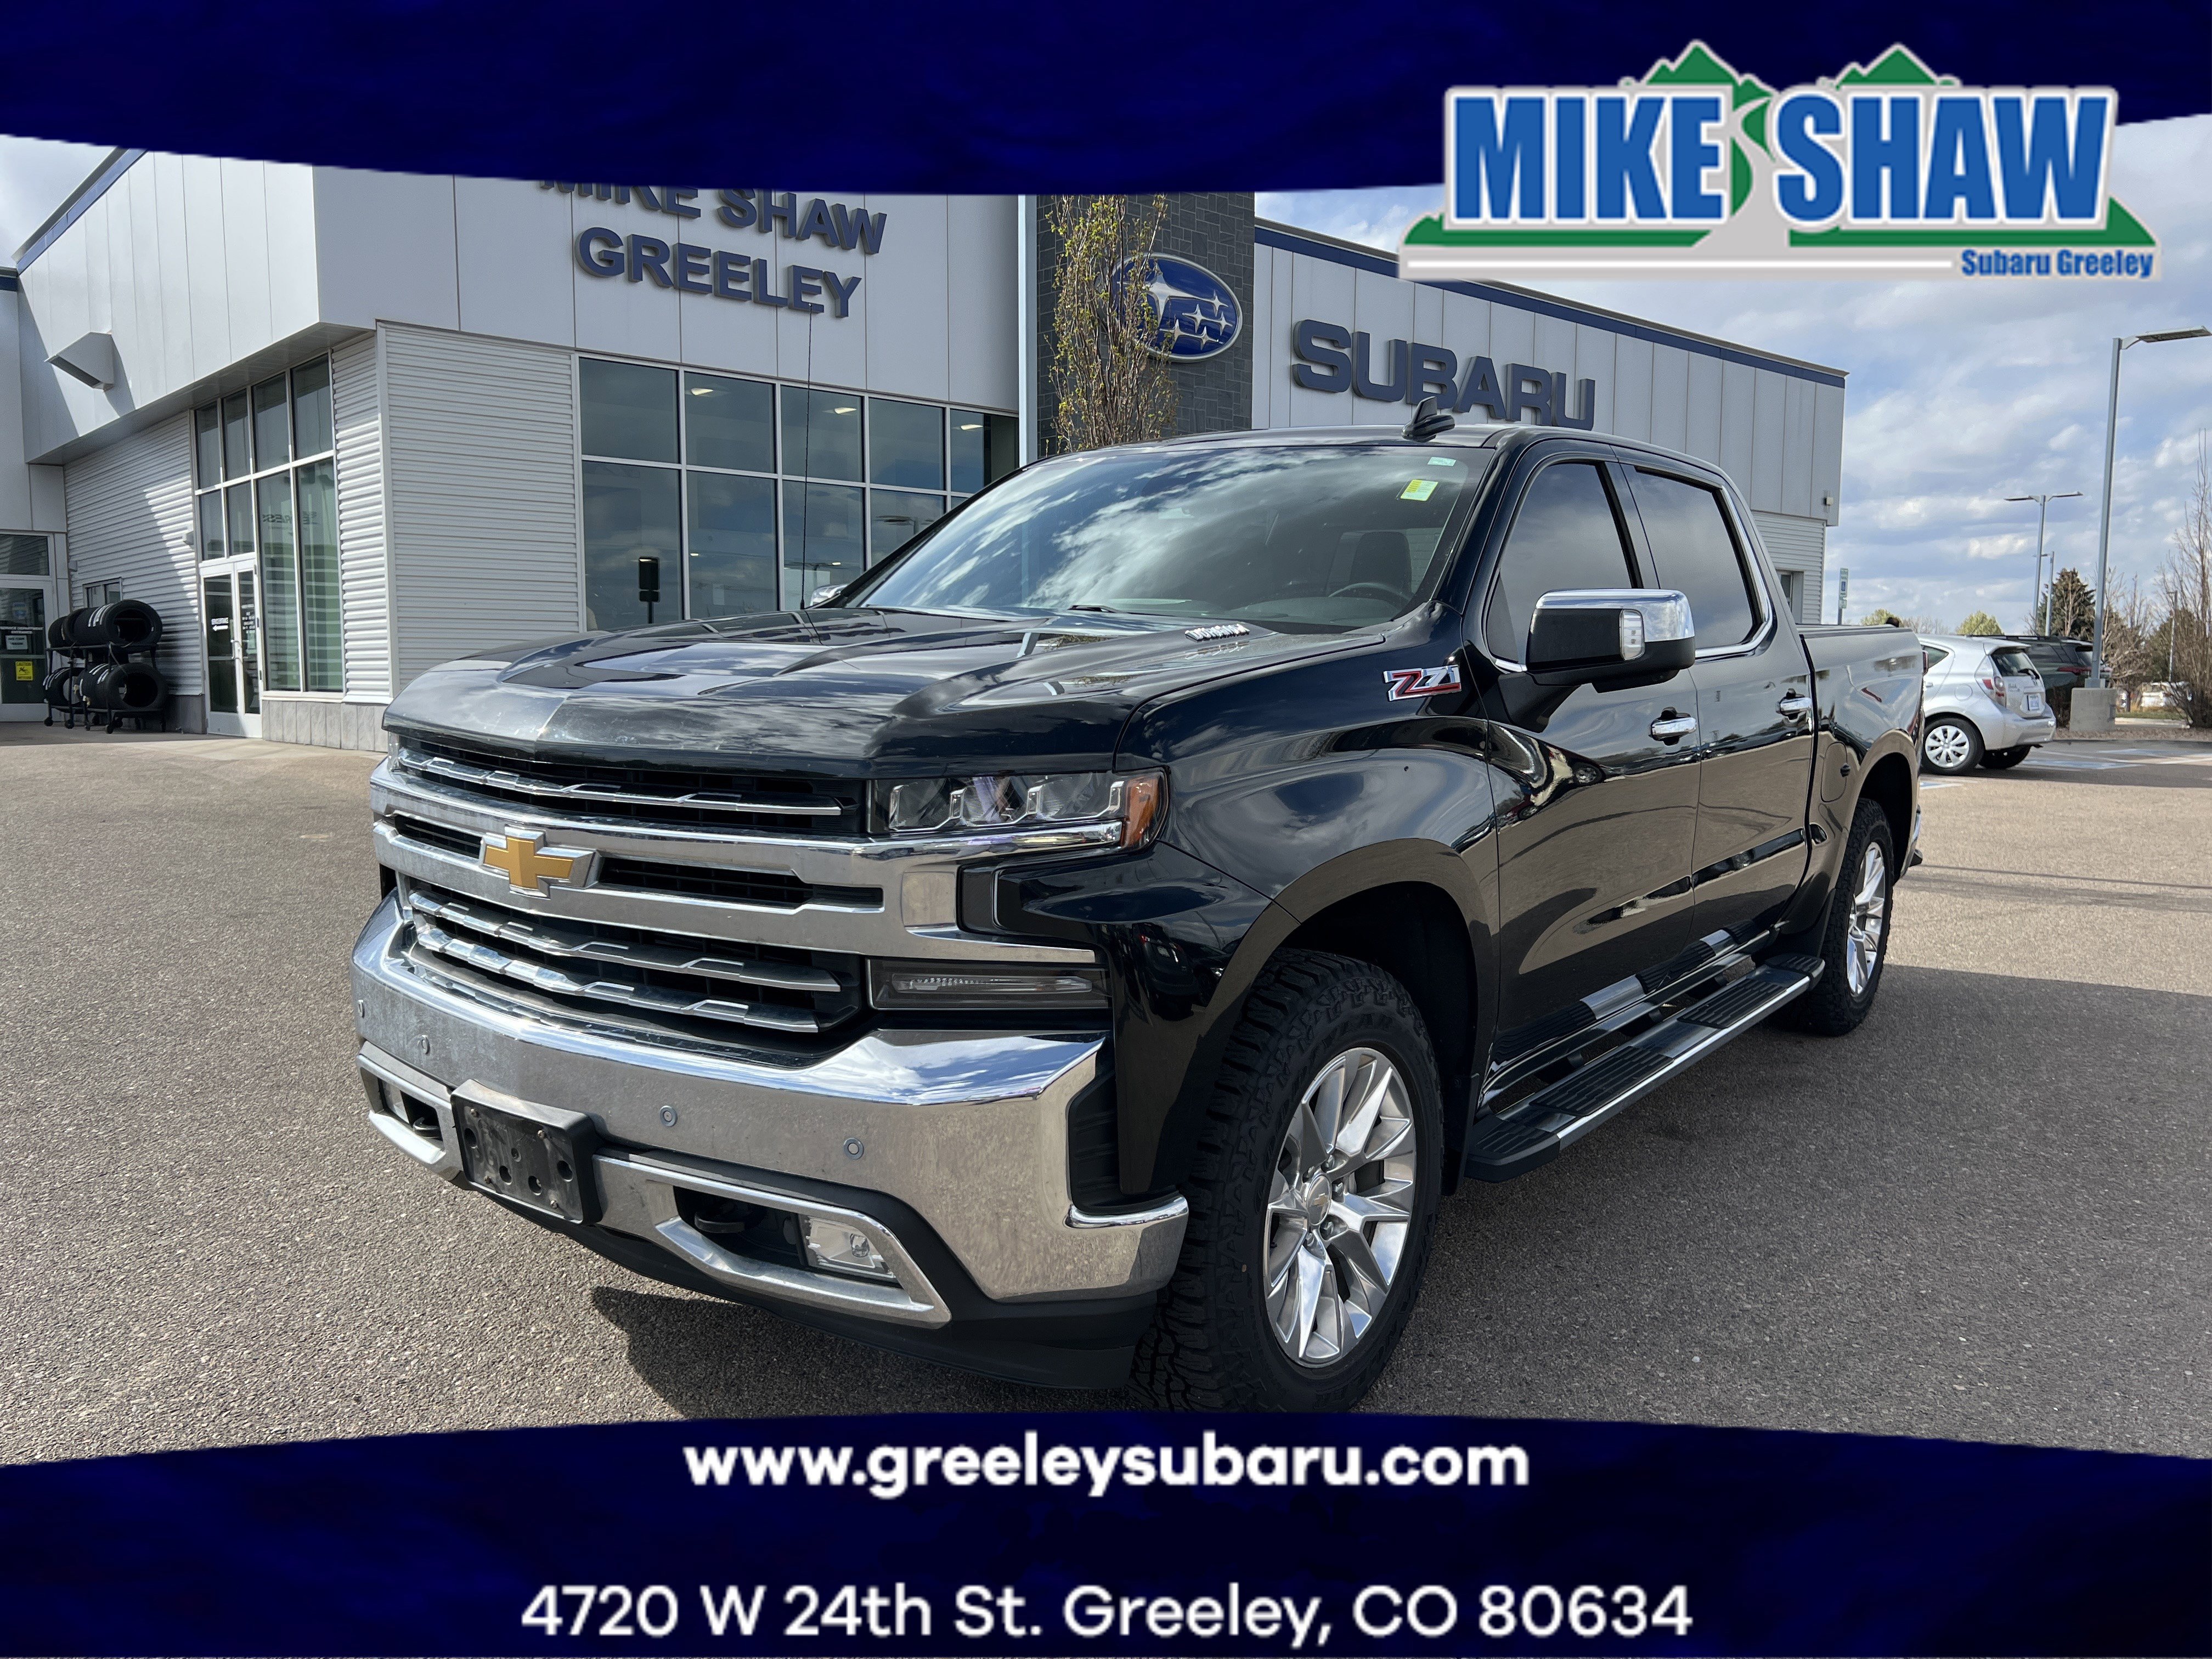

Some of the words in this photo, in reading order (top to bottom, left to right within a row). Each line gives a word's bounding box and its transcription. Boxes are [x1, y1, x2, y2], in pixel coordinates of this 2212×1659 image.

[717, 188, 887, 254] SHAW
[574, 227, 862, 317] GREELEY
[1292, 319, 1595, 430] SUBARU
[1384, 664, 1462, 702] Z71
